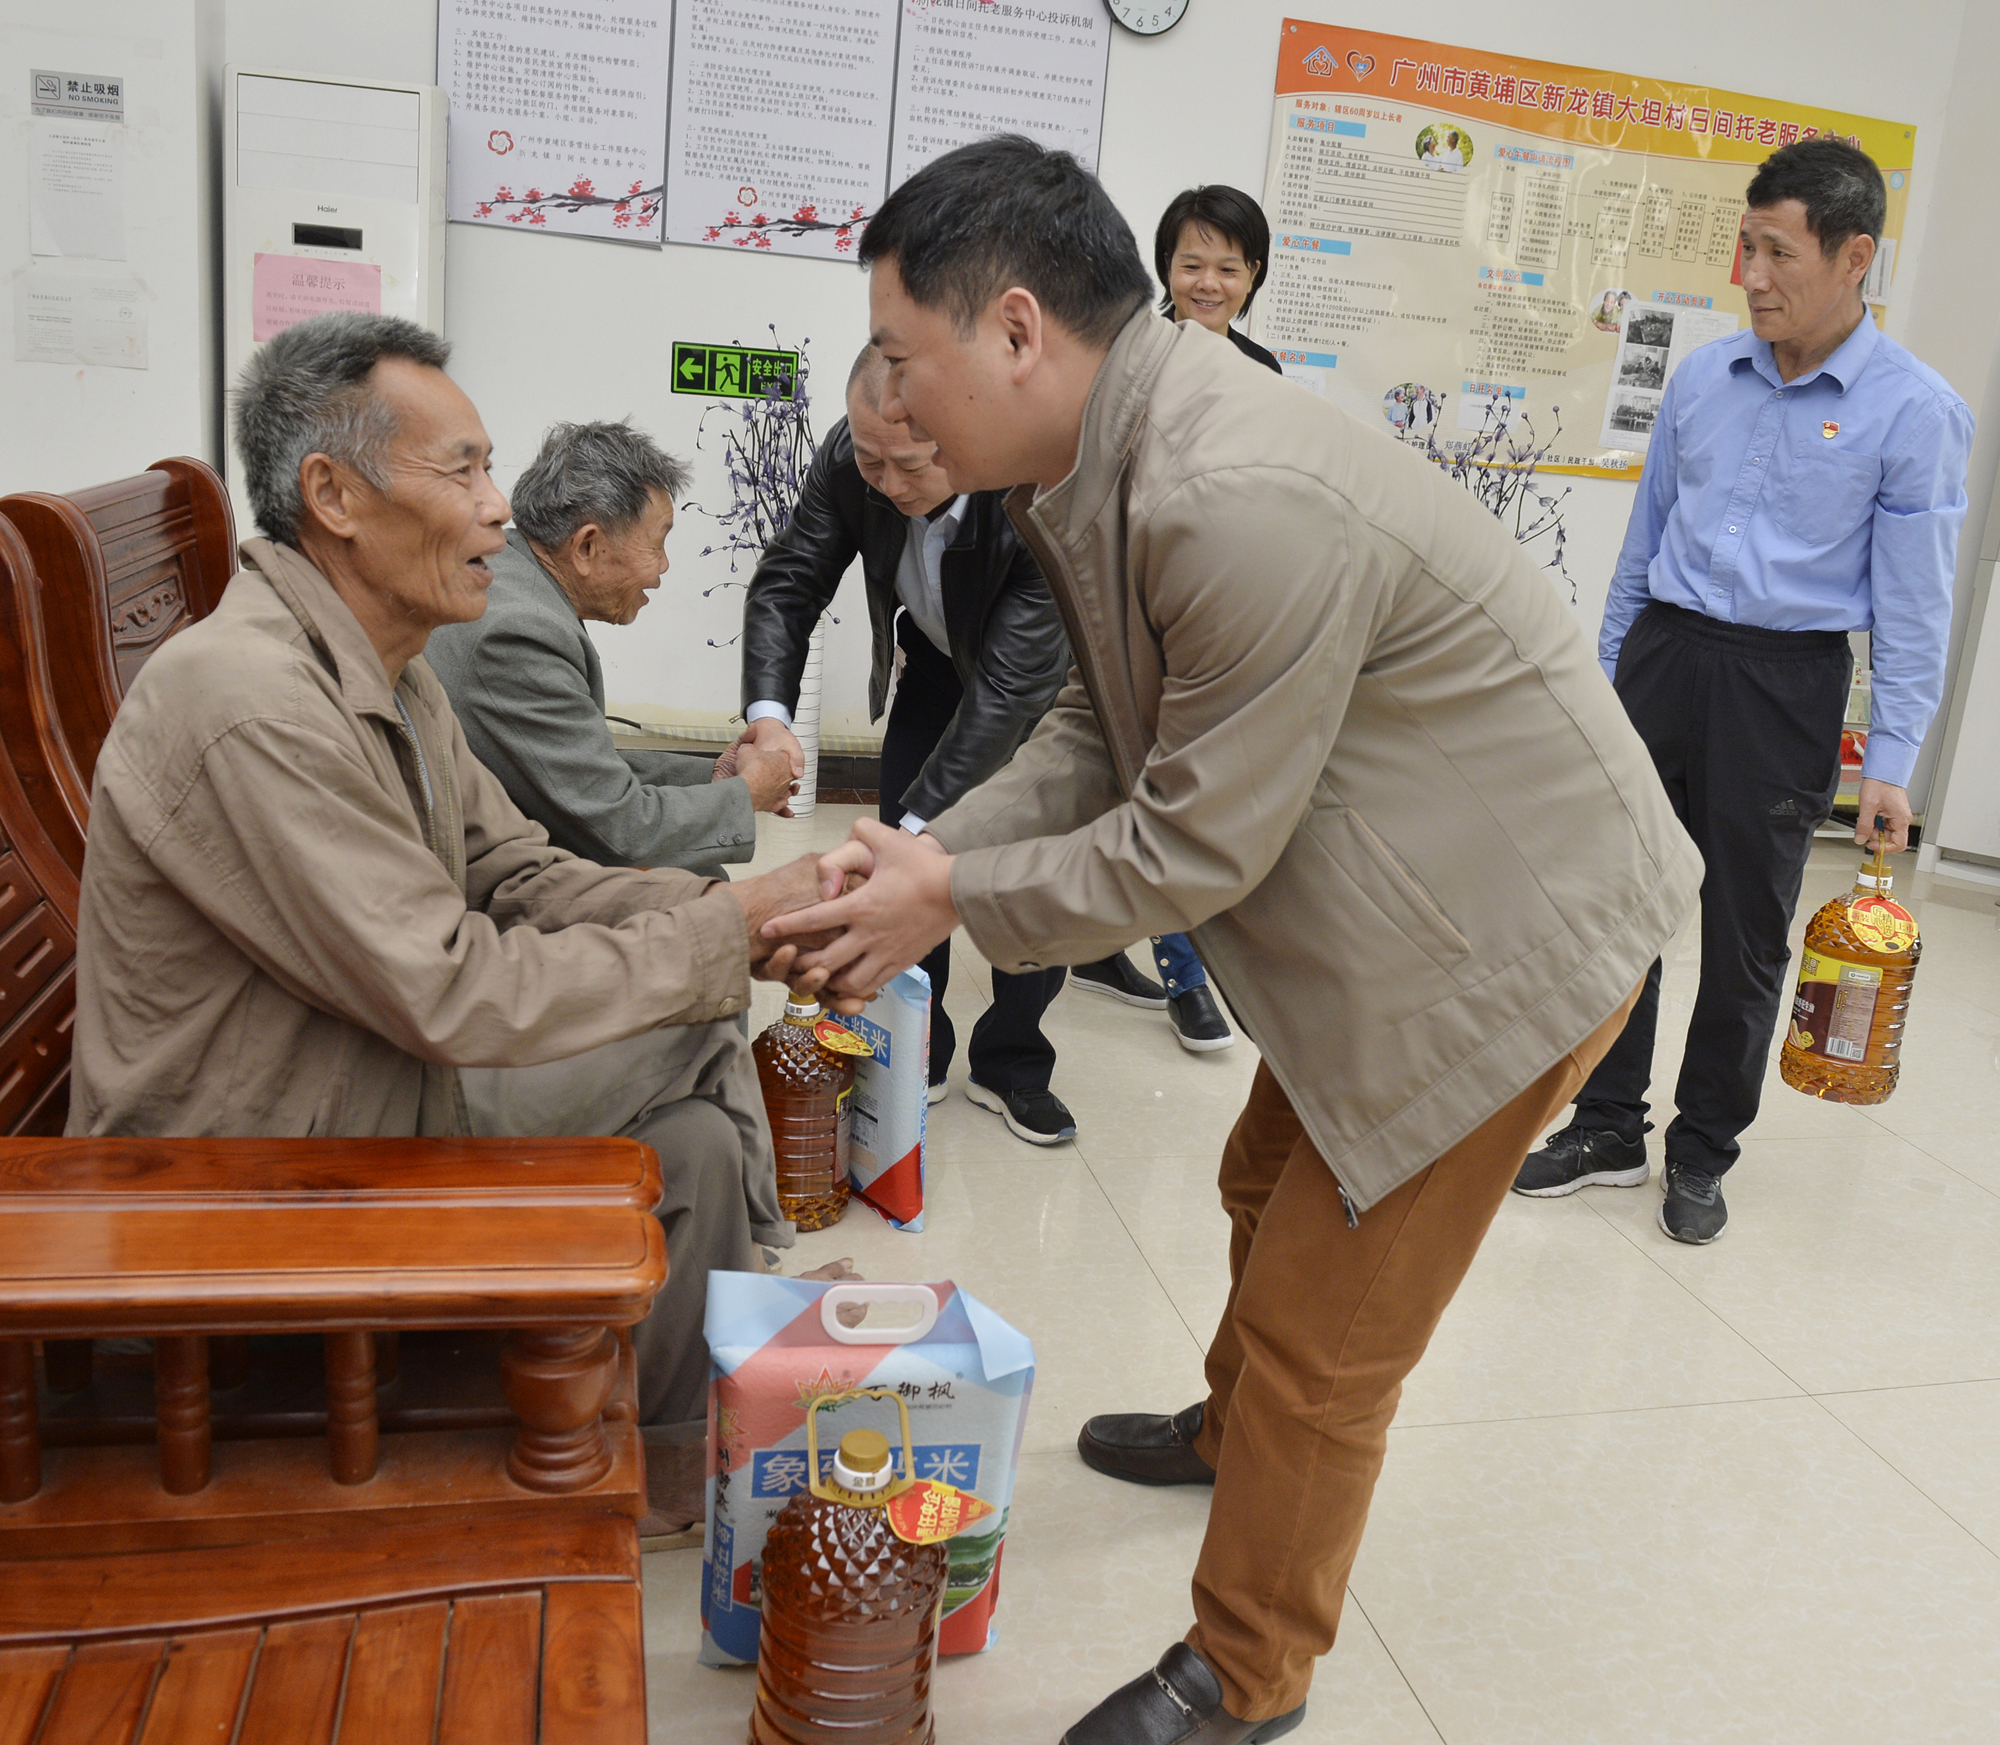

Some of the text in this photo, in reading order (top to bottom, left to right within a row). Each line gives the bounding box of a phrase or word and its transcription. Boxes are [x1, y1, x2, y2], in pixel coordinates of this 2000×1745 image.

[1123, 7, 1131, 18] 7
[1164, 6, 1172, 17] 4
[1136, 16, 1144, 28] 6
[1151, 14, 1160, 26] 5
[67, 79, 119, 97] 禁止吸烟
[81, 96, 119, 105] SMOKING
[1296, 117, 1335, 132] 服务项目
[1498, 147, 1571, 168] 爱心午餐申请流程图
[317, 205, 338, 213] Haier
[1282, 236, 1320, 251] 爱心午餐
[292, 273, 346, 290] 温馨提示
[1487, 269, 1521, 282] 文明公约
[1657, 292, 1708, 308] 开心活动剪影
[752, 359, 793, 378] 安全出口
[1469, 383, 1503, 395] 日托名单
[1770, 808, 1798, 816] adidas
[1852, 911, 1870, 922] 新装
[762, 1449, 971, 1499] 象米
[916, 1489, 942, 1538] 责任央企
